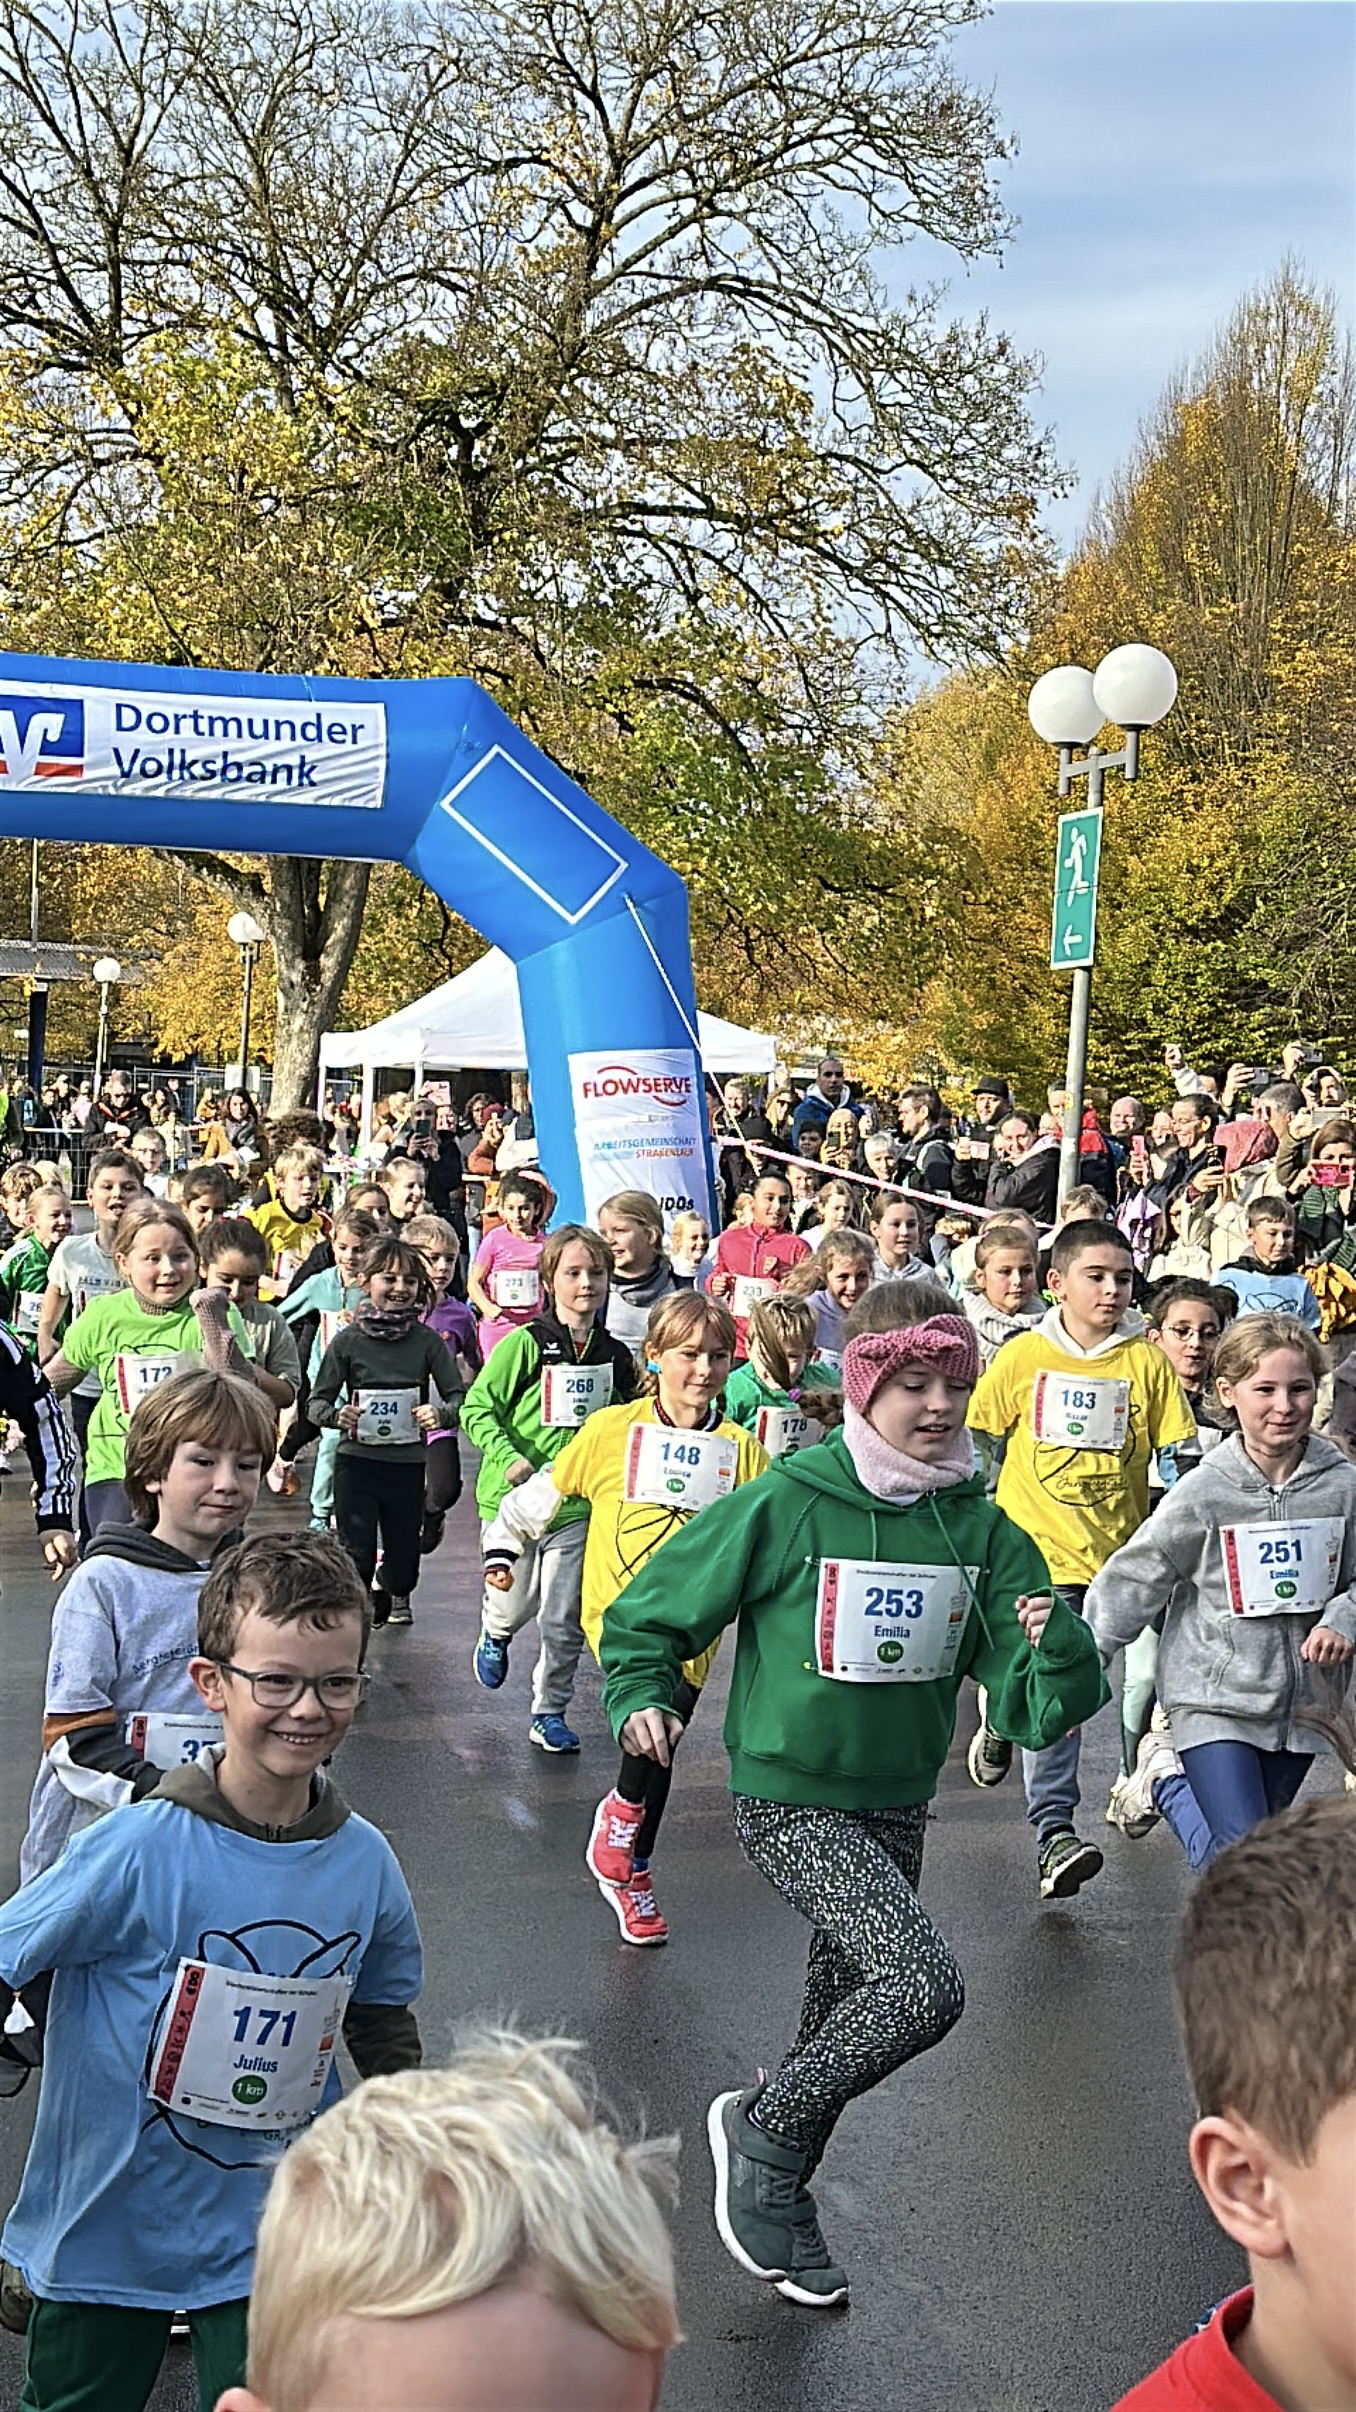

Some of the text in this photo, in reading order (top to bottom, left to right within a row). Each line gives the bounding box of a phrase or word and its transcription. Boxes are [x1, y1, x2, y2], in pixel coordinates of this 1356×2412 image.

[115, 702, 366, 745] Dortmunder
[112, 747, 319, 787] Volksbank
[582, 1077, 692, 1098] FLOWSERVE
[370, 1401, 399, 1416] 234
[1062, 1389, 1097, 1410] 183
[782, 1418, 807, 1433] 178
[661, 1441, 701, 1466] 148
[1258, 1539, 1302, 1564] 251
[864, 1587, 924, 1619] 253
[874, 1625, 911, 1639] Emilia
[233, 2006, 297, 2047] 171
[233, 2053, 279, 2073] Julius
[236, 2082, 264, 2096] 1 km
